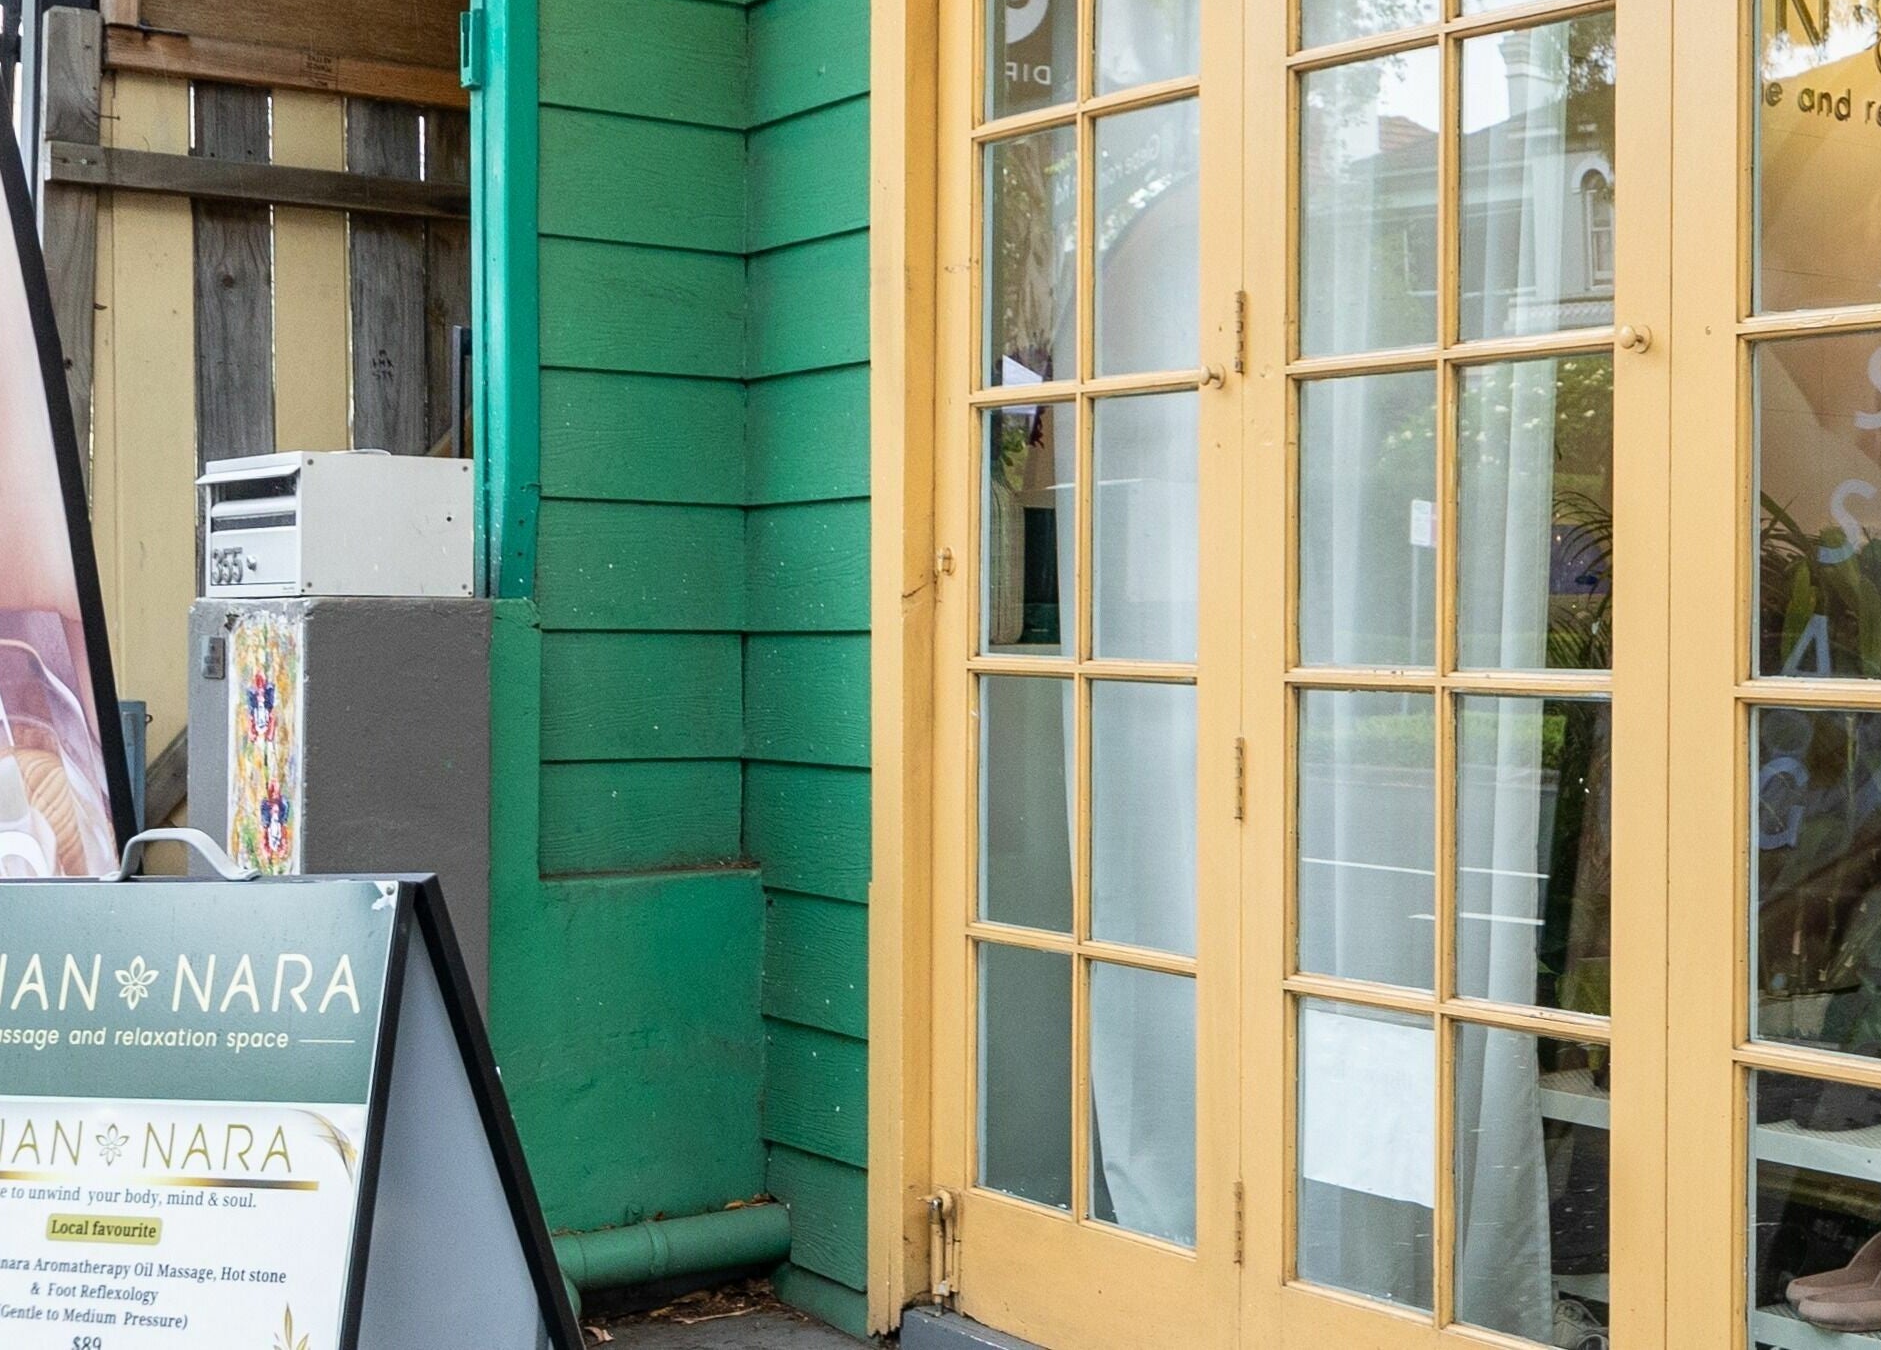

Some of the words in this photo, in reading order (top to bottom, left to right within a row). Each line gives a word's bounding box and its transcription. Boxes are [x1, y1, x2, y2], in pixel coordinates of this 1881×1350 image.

[1798, 86, 1852, 123] and
[211, 546, 243, 584] 355
[172, 953, 361, 1014] NARA
[69, 1027, 107, 1046] and
[114, 1028, 217, 1048] relaxation
[226, 1031, 289, 1053] space
[142, 1122, 292, 1173] NARA
[11, 1186, 25, 1199] to
[28, 1186, 81, 1201] unwind
[88, 1191, 121, 1206] your
[124, 1188, 163, 1208] body,
[166, 1190, 204, 1206] mind
[207, 1192, 219, 1206] &
[222, 1193, 257, 1208] soul.
[51, 1219, 89, 1235] Local
[92, 1221, 157, 1238] favourite
[33, 1258, 131, 1280] Aromatherapy
[134, 1262, 153, 1277] Oil
[156, 1264, 217, 1283] Massage,
[221, 1267, 246, 1282] Hot
[249, 1269, 287, 1283] stone
[30, 1281, 41, 1295] &
[47, 1283, 76, 1297] Foot
[80, 1284, 159, 1306] Reflexology
[0, 1304, 43, 1319] Gentle
[46, 1308, 59, 1321] to
[62, 1308, 116, 1324] Medium
[123, 1312, 188, 1330] Pressure)
